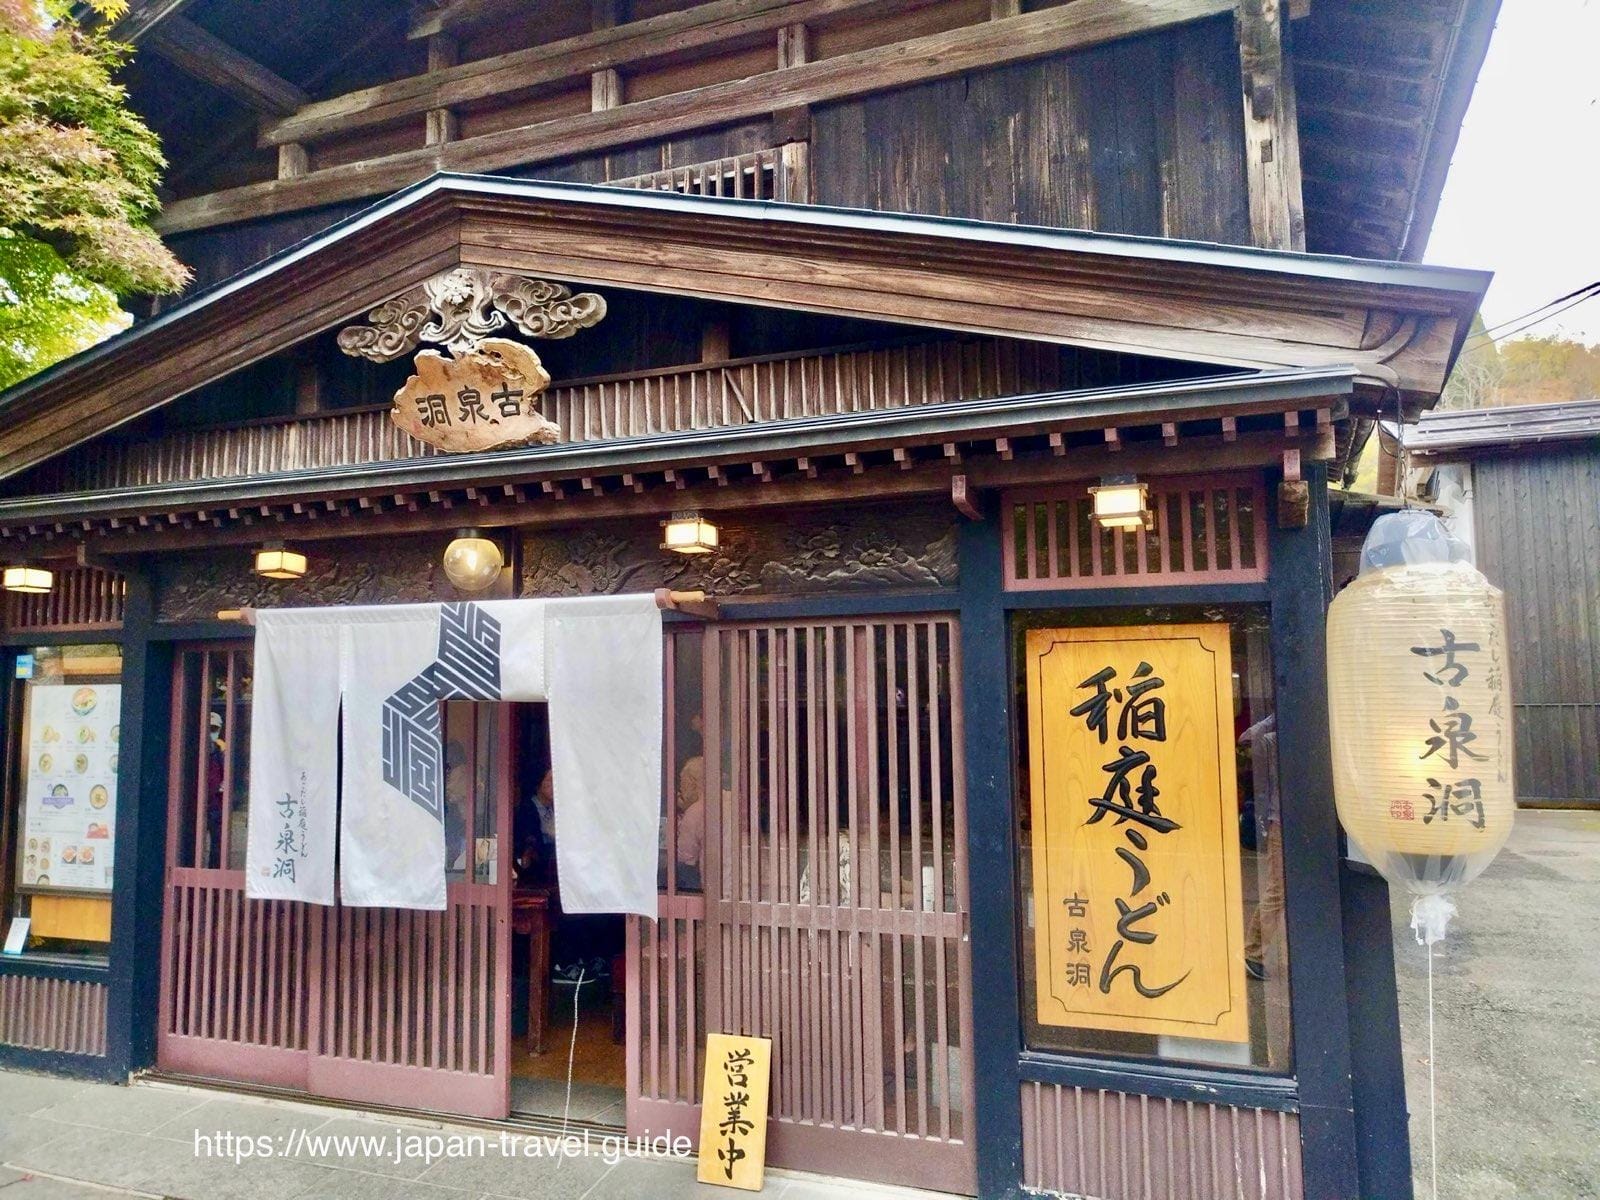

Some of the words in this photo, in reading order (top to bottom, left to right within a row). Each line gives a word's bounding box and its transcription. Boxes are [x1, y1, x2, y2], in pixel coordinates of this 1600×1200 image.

[415, 382, 523, 428] 古泉洞
[1409, 628, 1489, 833] 古泉洞
[273, 792, 298, 883] 古泉洞
[1069, 660, 1192, 999] 稲庭うどん
[1062, 891, 1092, 989] 古泉洞
[717, 1048, 755, 1180] 営業中
